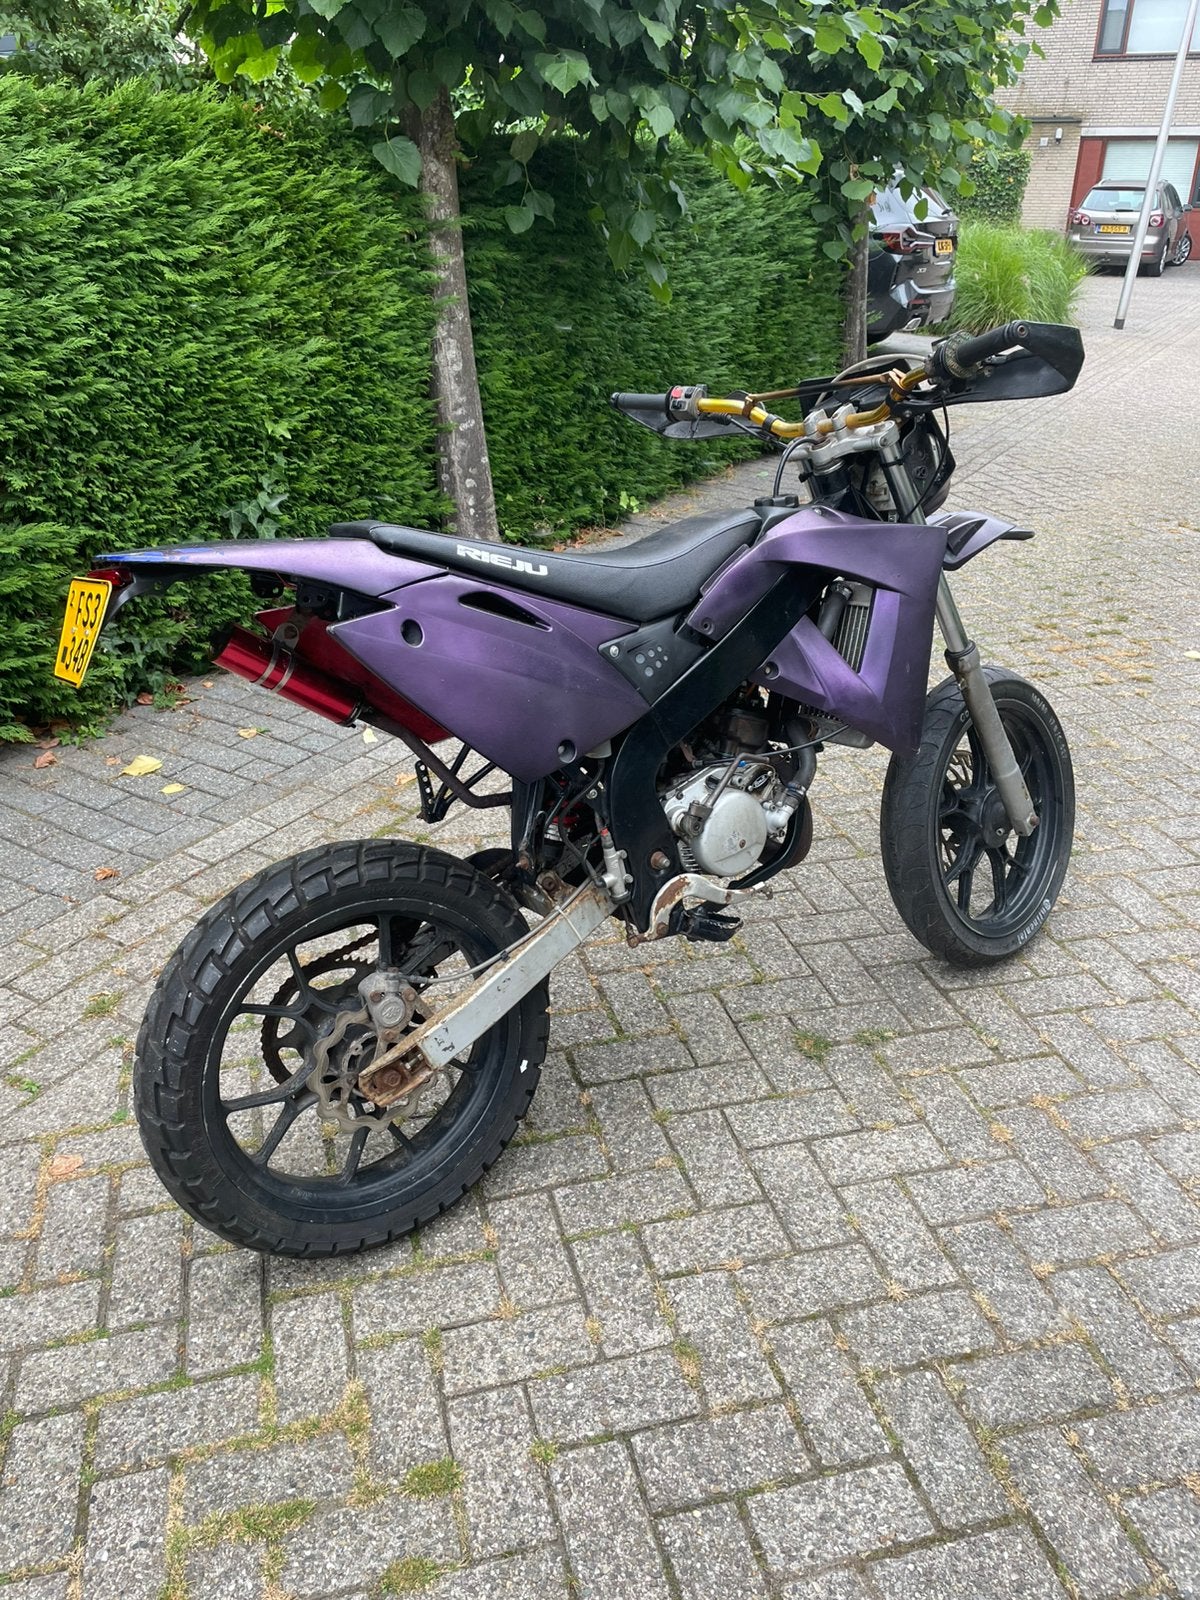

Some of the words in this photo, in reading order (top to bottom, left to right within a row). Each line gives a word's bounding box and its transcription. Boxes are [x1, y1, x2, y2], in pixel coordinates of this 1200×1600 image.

[457, 544, 548, 576] RIEJU
[70, 590, 75, 607] 2
[76, 591, 101, 629] FS3
